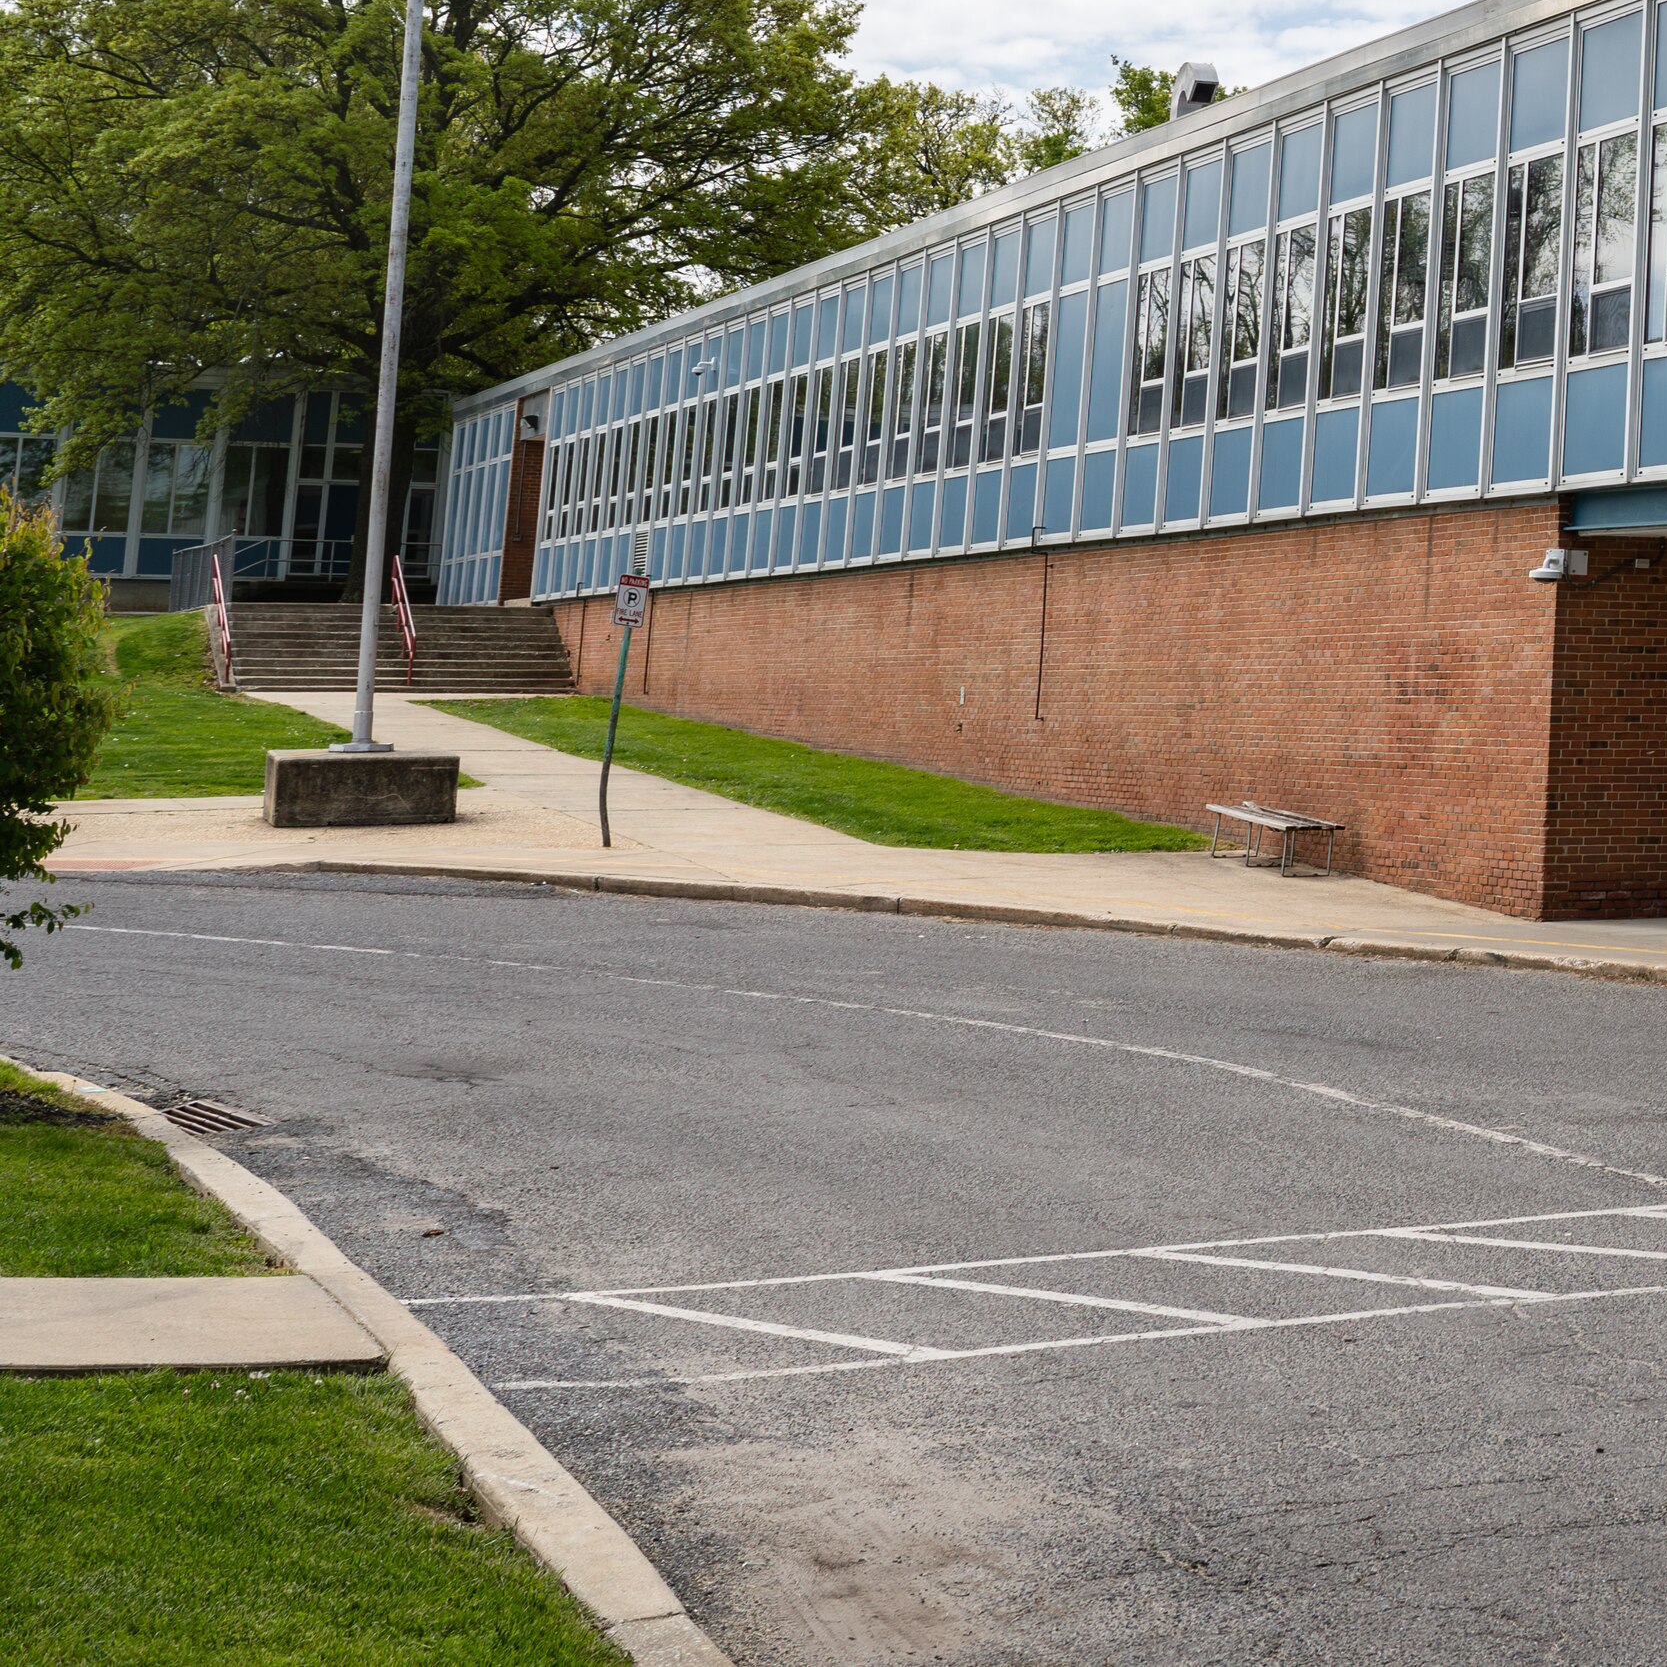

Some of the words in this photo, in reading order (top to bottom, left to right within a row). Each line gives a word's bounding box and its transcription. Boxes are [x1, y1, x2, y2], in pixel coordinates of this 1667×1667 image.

[621, 576, 628, 584] NO
[629, 578, 648, 587] PARKING
[616, 608, 627, 616] FIRE
[629, 609, 643, 618] LANE
